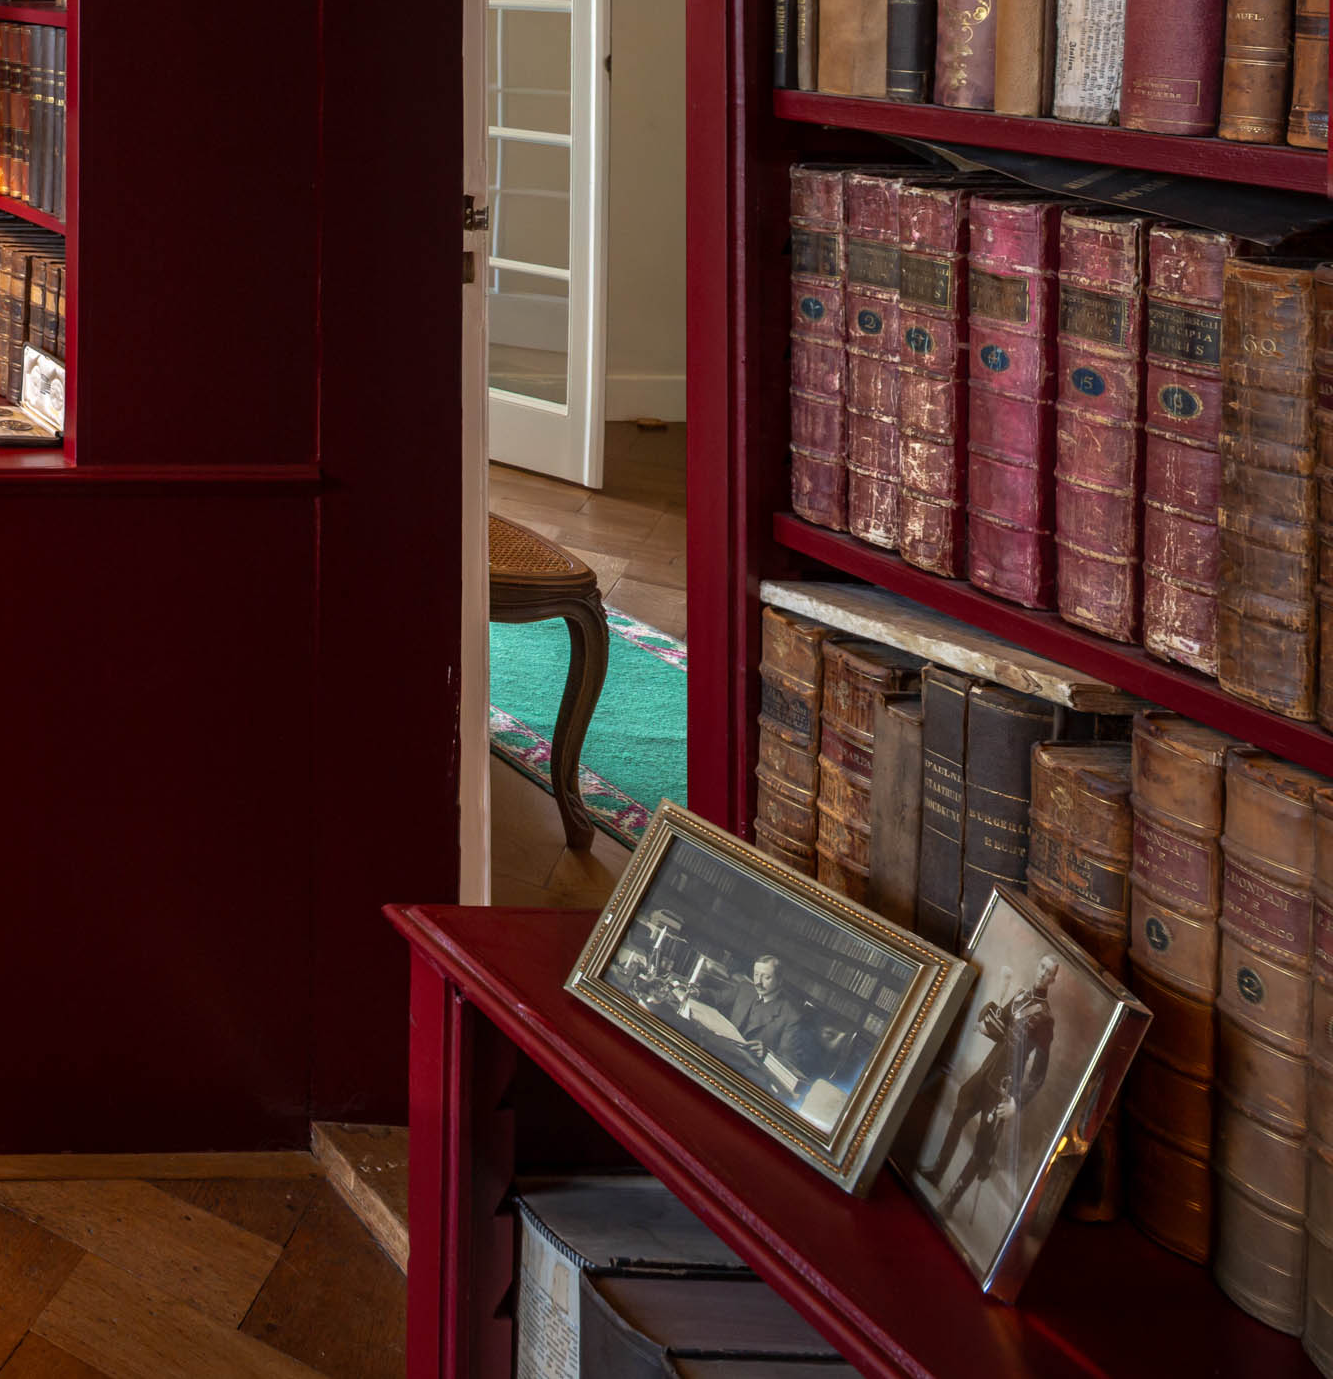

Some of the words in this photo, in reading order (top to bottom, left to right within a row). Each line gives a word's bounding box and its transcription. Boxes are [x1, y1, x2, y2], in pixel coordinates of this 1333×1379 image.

[864, 315, 876, 329] 2
[1081, 375, 1094, 390] 5
[925, 759, 963, 782] D'AULNI
[1243, 977, 1259, 994] 2
